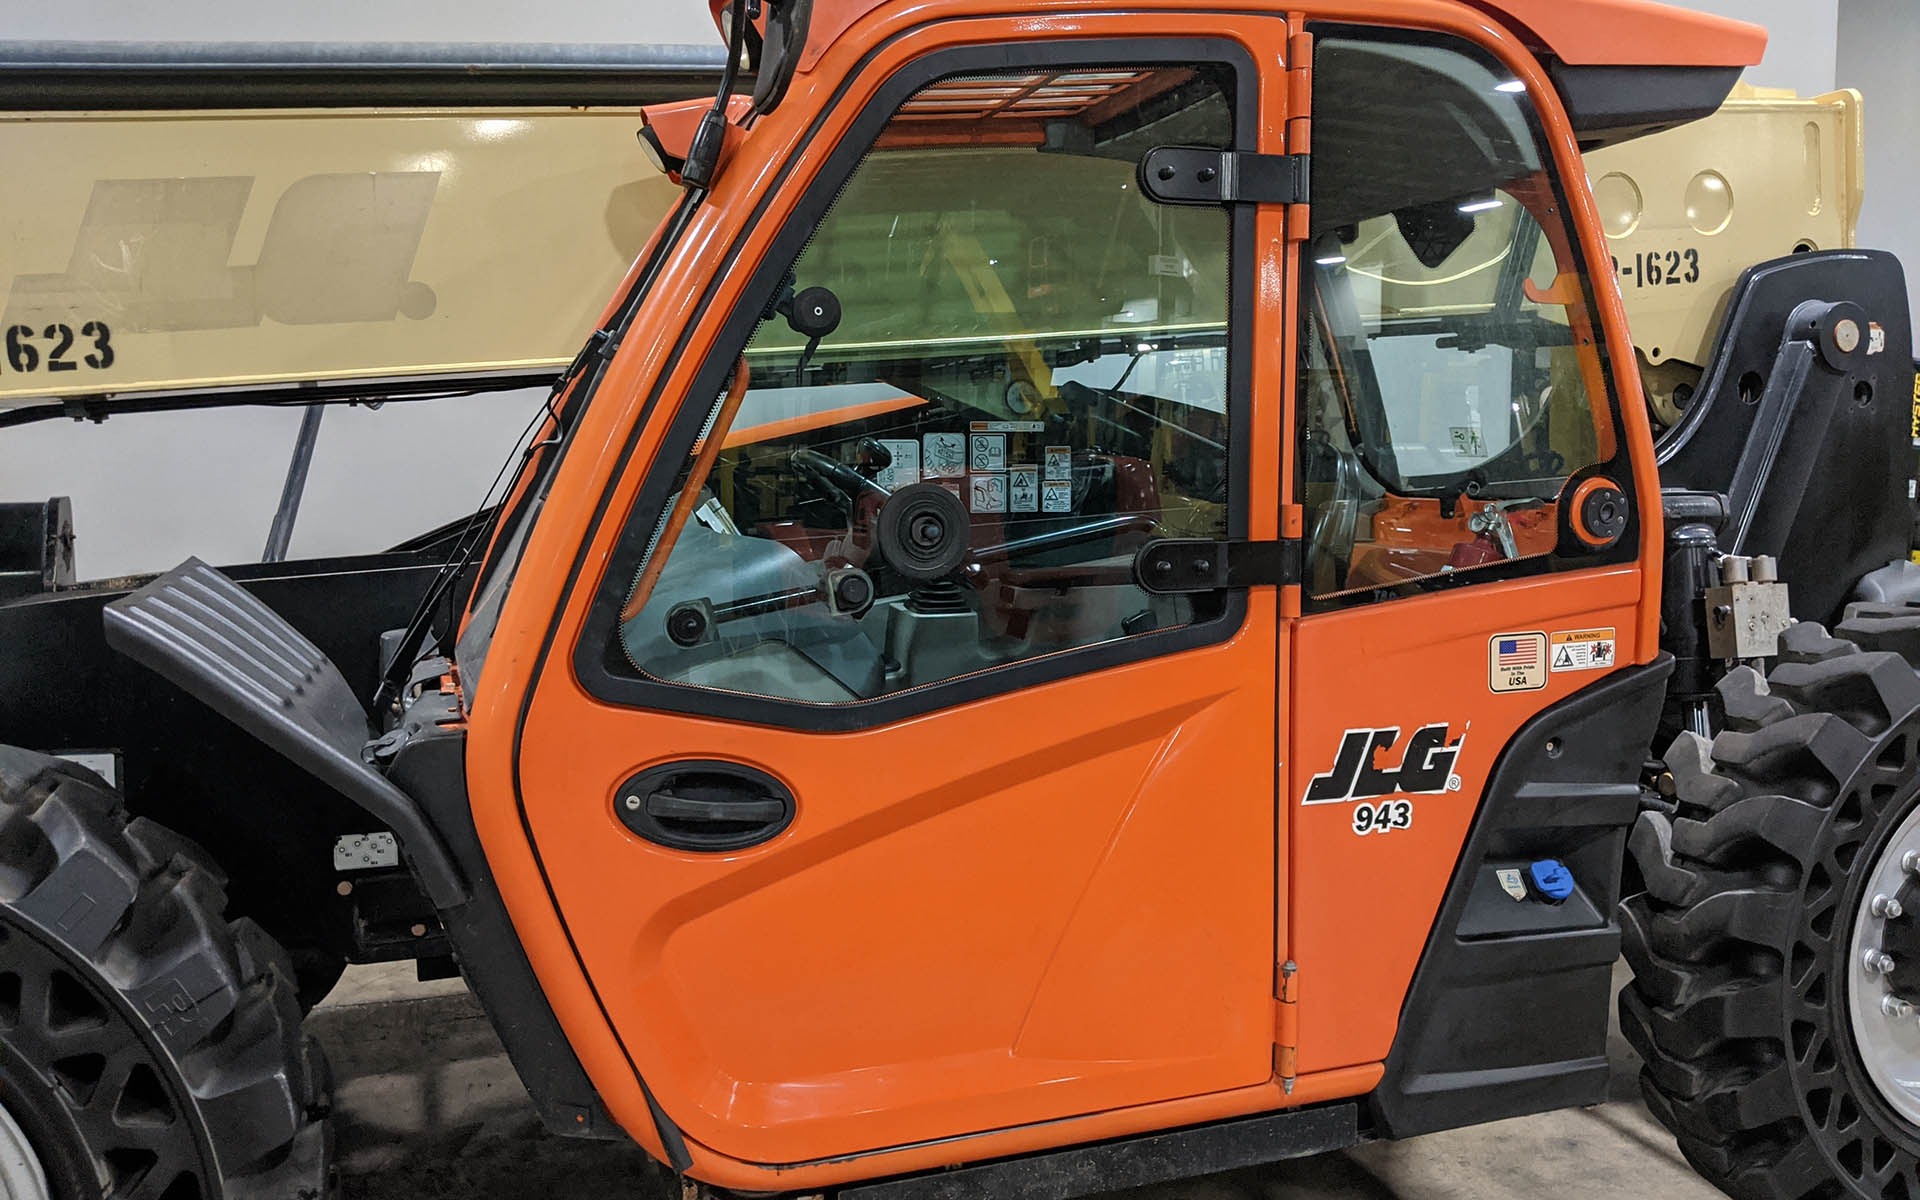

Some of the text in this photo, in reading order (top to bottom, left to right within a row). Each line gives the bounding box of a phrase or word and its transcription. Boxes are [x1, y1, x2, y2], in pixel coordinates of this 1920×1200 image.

[0, 321, 114, 374] 623
[1509, 676, 1527, 686] USA
[1303, 723, 1460, 804] JLG
[1354, 801, 1411, 833] 943
